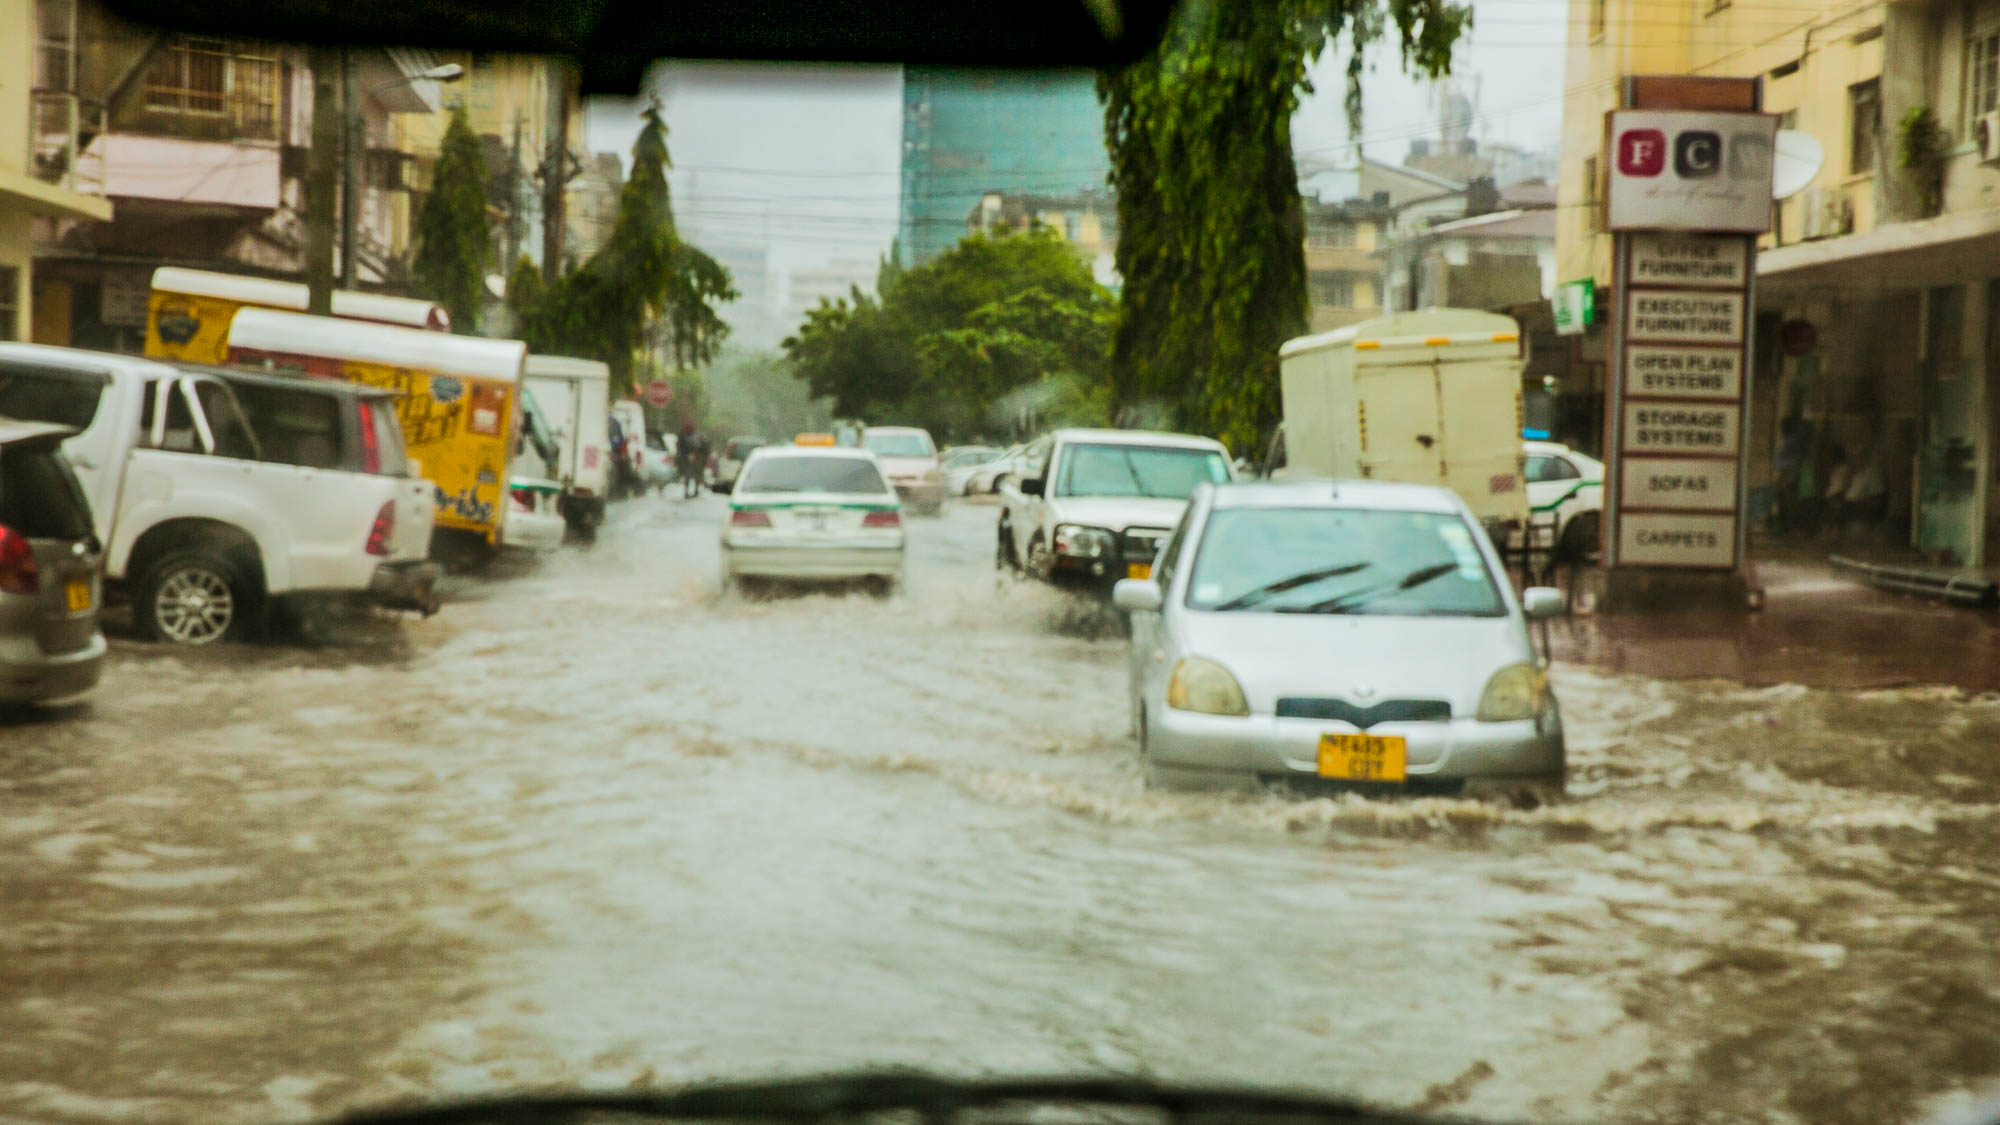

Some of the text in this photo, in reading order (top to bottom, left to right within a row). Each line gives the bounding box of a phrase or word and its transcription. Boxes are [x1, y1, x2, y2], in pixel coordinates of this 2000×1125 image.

[1657, 242, 1719, 258] OFFICE
[1639, 260, 1735, 278] FURNITURE
[1637, 299, 1732, 314] EXECUTIVE
[1635, 317, 1732, 333] FURNITURE
[1635, 355, 1732, 370] OPEN PLAN
[1643, 374, 1723, 390] SYSTEMS
[1637, 411, 1726, 427] STORAGE
[1637, 429, 1724, 446] SYSTEMS
[1649, 475, 1708, 492] SOFAS
[1636, 529, 1718, 548] CARPETS
